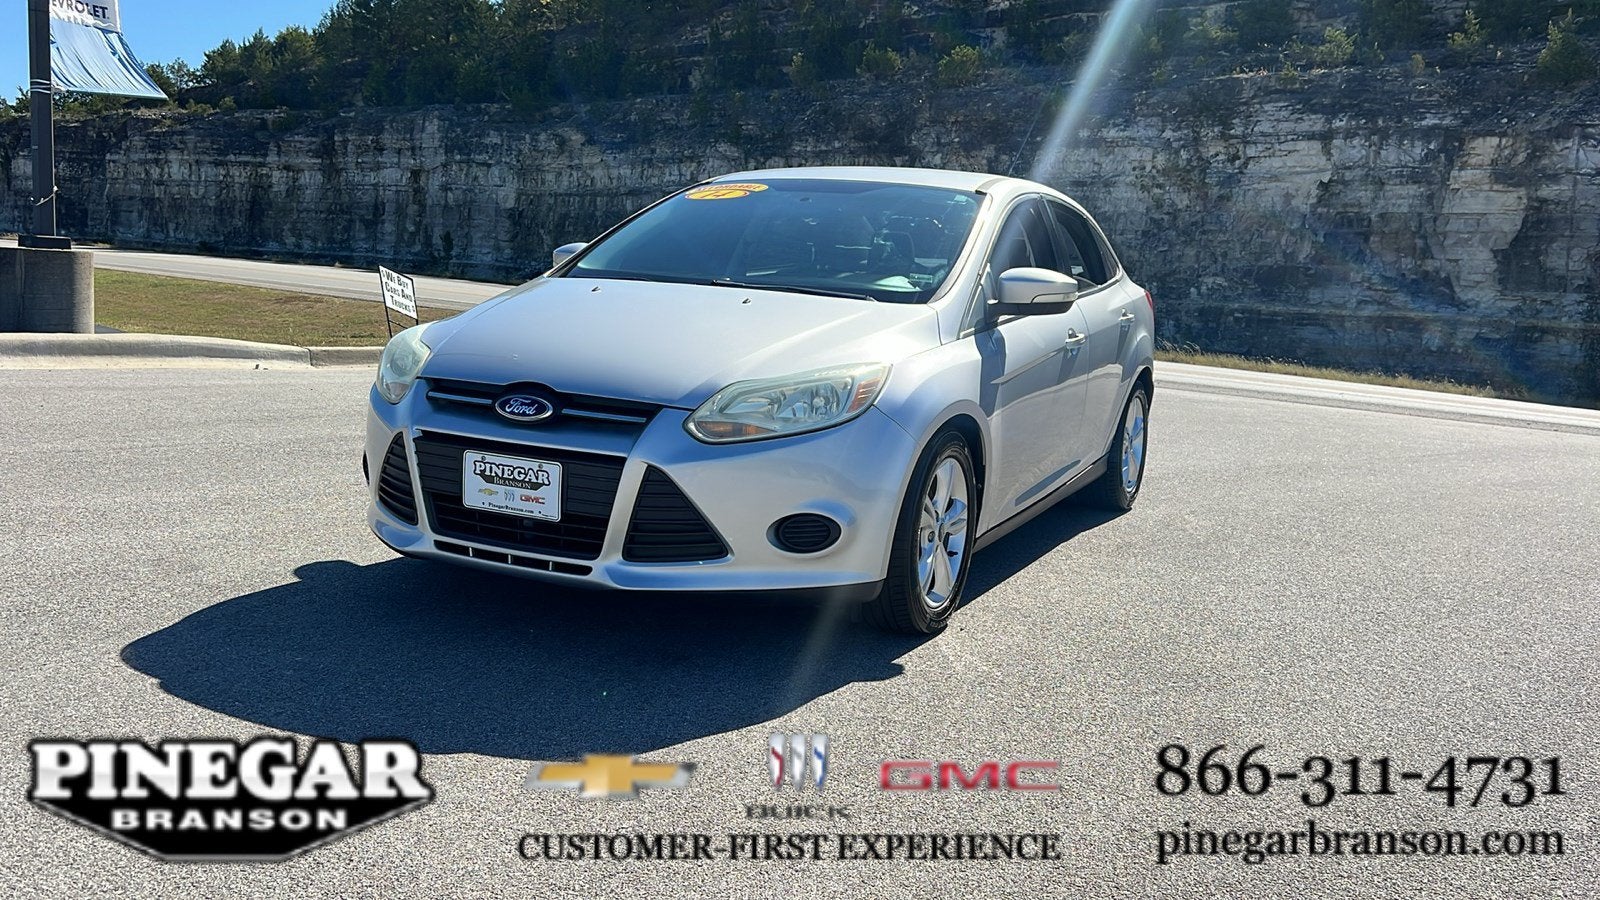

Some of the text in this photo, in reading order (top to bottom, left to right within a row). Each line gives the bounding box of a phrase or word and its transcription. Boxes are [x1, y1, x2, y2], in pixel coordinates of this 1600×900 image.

[505, 397, 538, 415] Ford
[473, 460, 551, 486] PINEGAR
[494, 477, 531, 489] BRANSON
[520, 494, 545, 505] GMC
